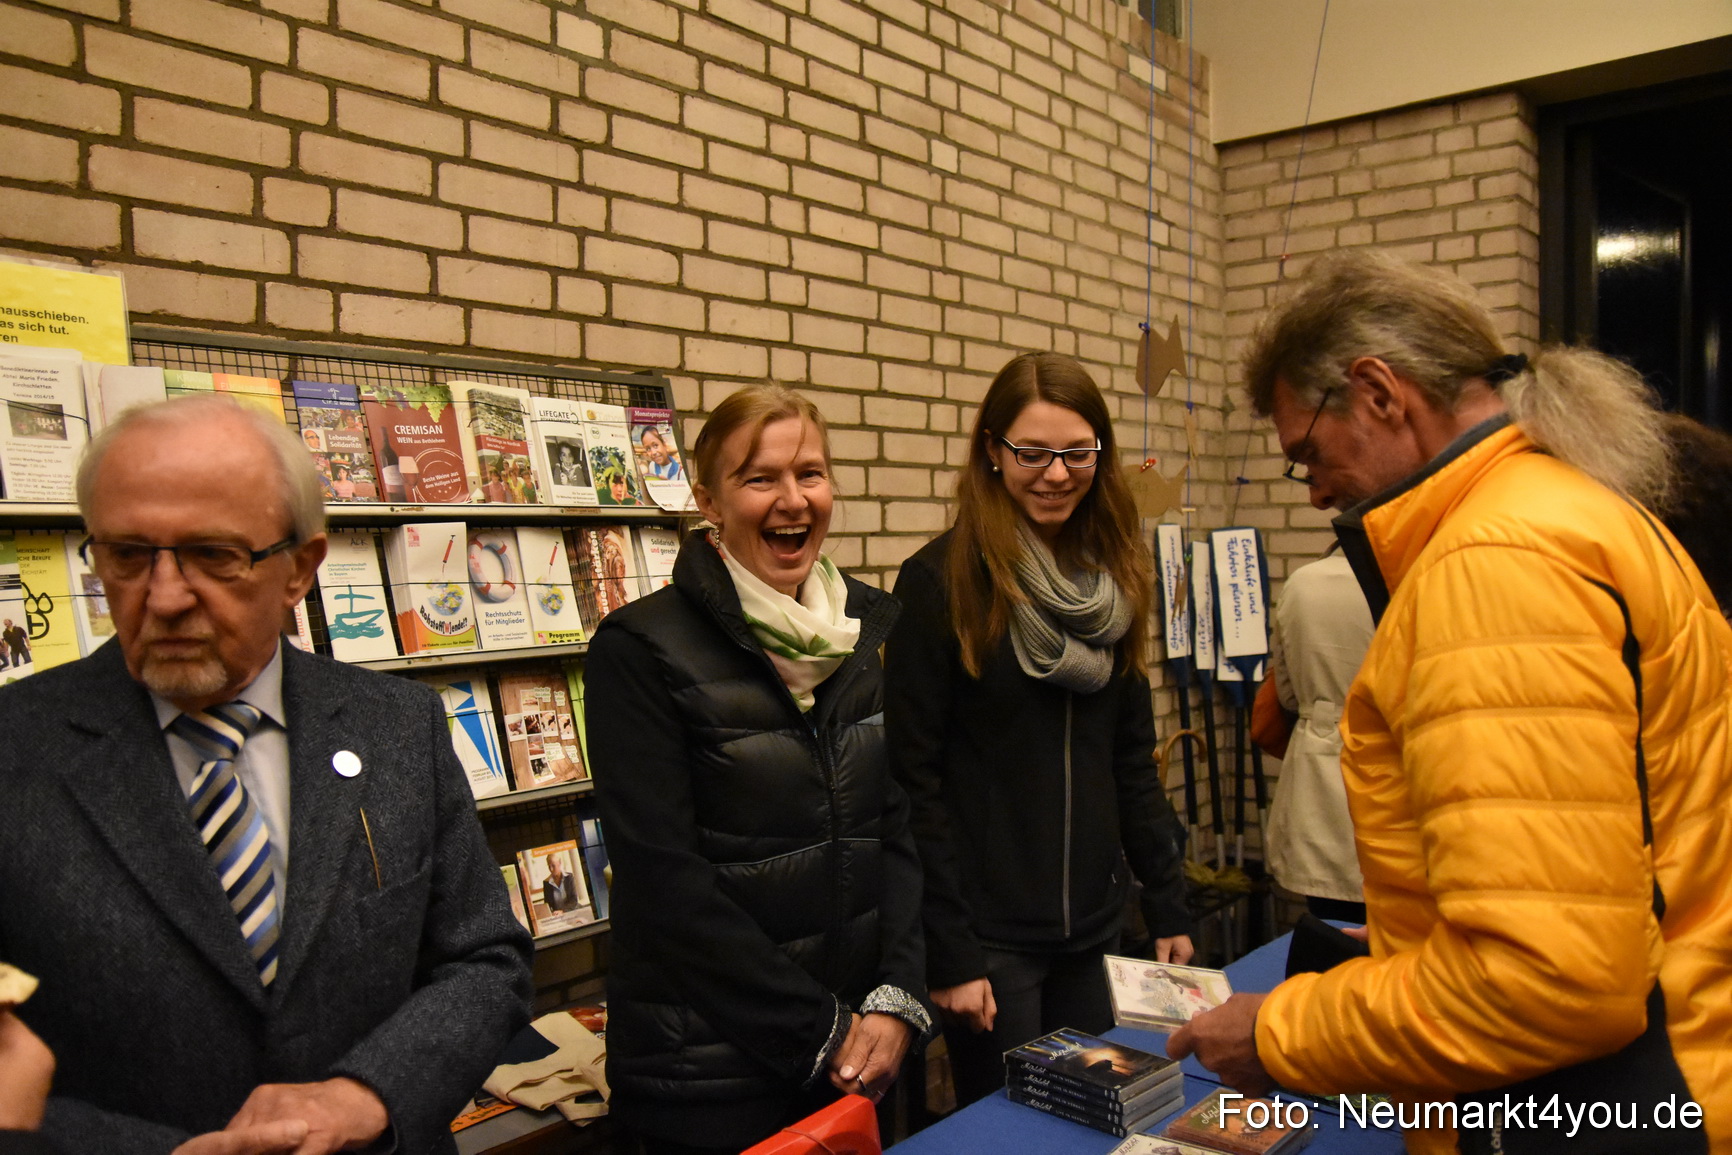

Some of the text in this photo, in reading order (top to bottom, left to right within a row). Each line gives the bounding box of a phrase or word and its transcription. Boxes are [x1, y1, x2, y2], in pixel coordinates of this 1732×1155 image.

[18, 321, 45, 332] sich
[49, 324, 69, 335] tut.
[538, 409, 570, 419] LIFEGATE
[634, 409, 671, 419] Monatsprojekte
[394, 424, 443, 435] CREMISAN
[328, 434, 359, 442] Lebendige
[396, 436, 413, 444] WEIN
[485, 610, 522, 618] Rechtsschutz
[495, 618, 525, 626] Mitglieder
